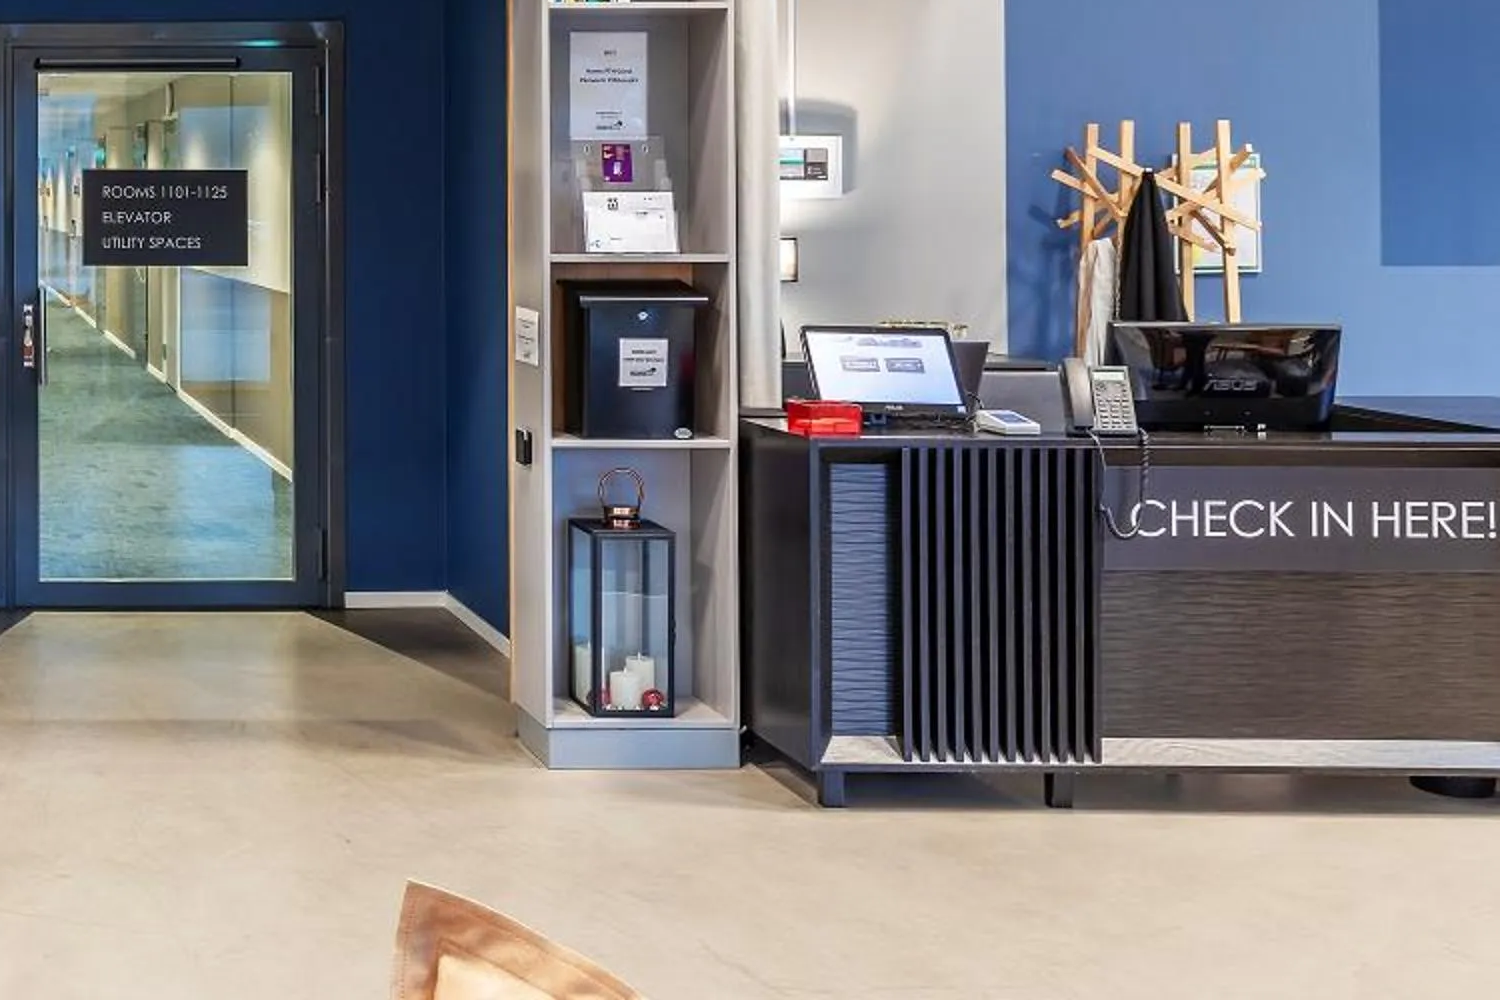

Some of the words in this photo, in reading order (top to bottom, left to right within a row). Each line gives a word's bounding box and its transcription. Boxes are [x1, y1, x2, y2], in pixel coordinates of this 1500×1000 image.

[102, 185, 157, 199] ROOMS
[160, 185, 228, 199] 1101-1125
[102, 211, 172, 225] ELEVATOR
[102, 236, 145, 249] UTILITY
[148, 236, 201, 249] SPACES
[1130, 499, 1295, 538] CHECK
[1311, 501, 1354, 537] IN
[1371, 500, 1497, 539] HERE!
